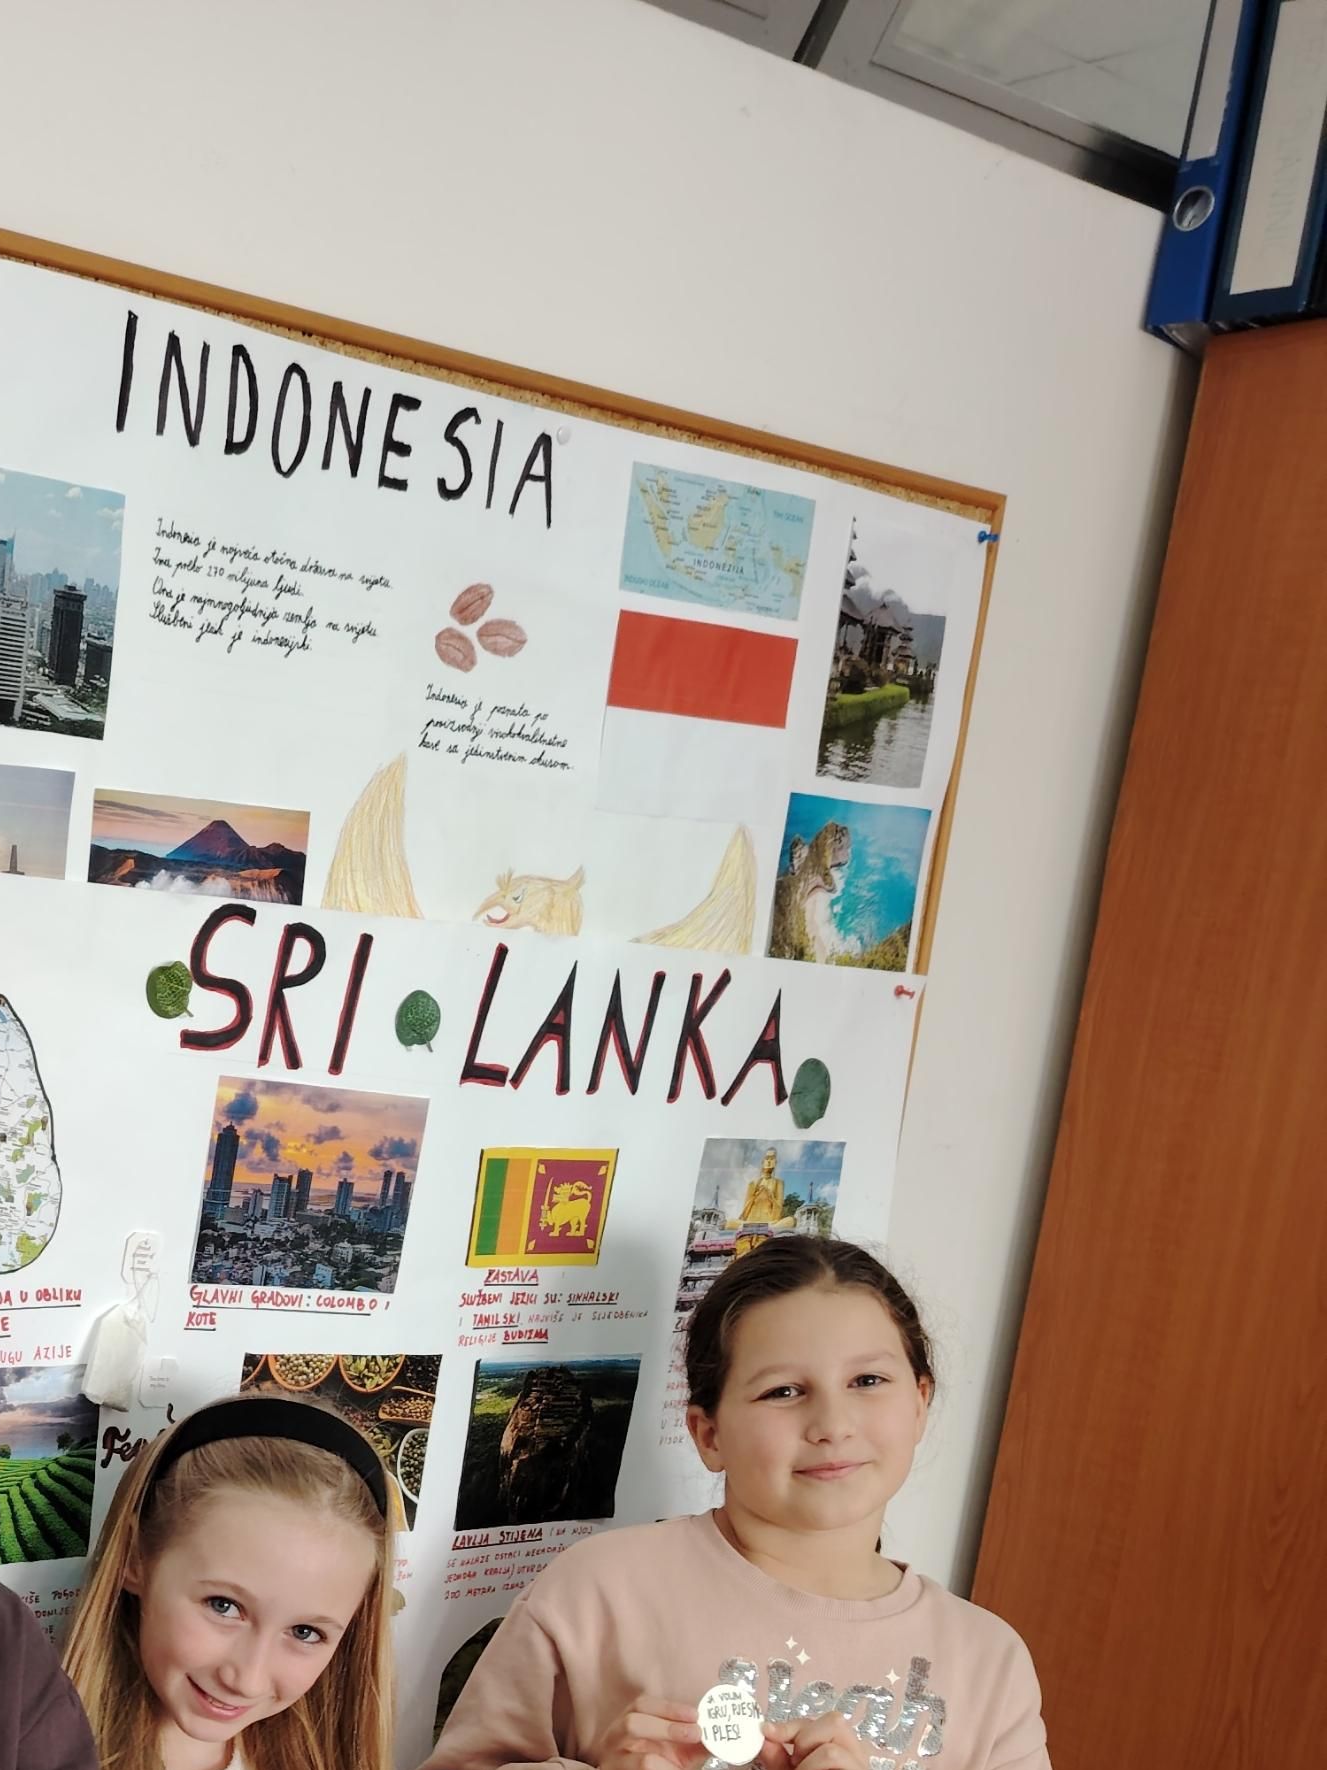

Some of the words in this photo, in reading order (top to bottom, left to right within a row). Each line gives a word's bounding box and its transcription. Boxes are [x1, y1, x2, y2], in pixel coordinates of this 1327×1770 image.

[116, 310, 553, 529] INDONESIA
[179, 903, 373, 1076] SRI
[459, 943, 788, 1107] LANKA
[484, 1268, 539, 1283] ZASTAVA
[19, 1290, 28, 1303] U
[36, 1287, 82, 1302] OBLIKU
[186, 1311, 216, 1328] KOTE
[33, 1345, 72, 1361] AZIJE
[499, 1528, 543, 1543] STIJENA
[703, 1726, 708, 1741] I
